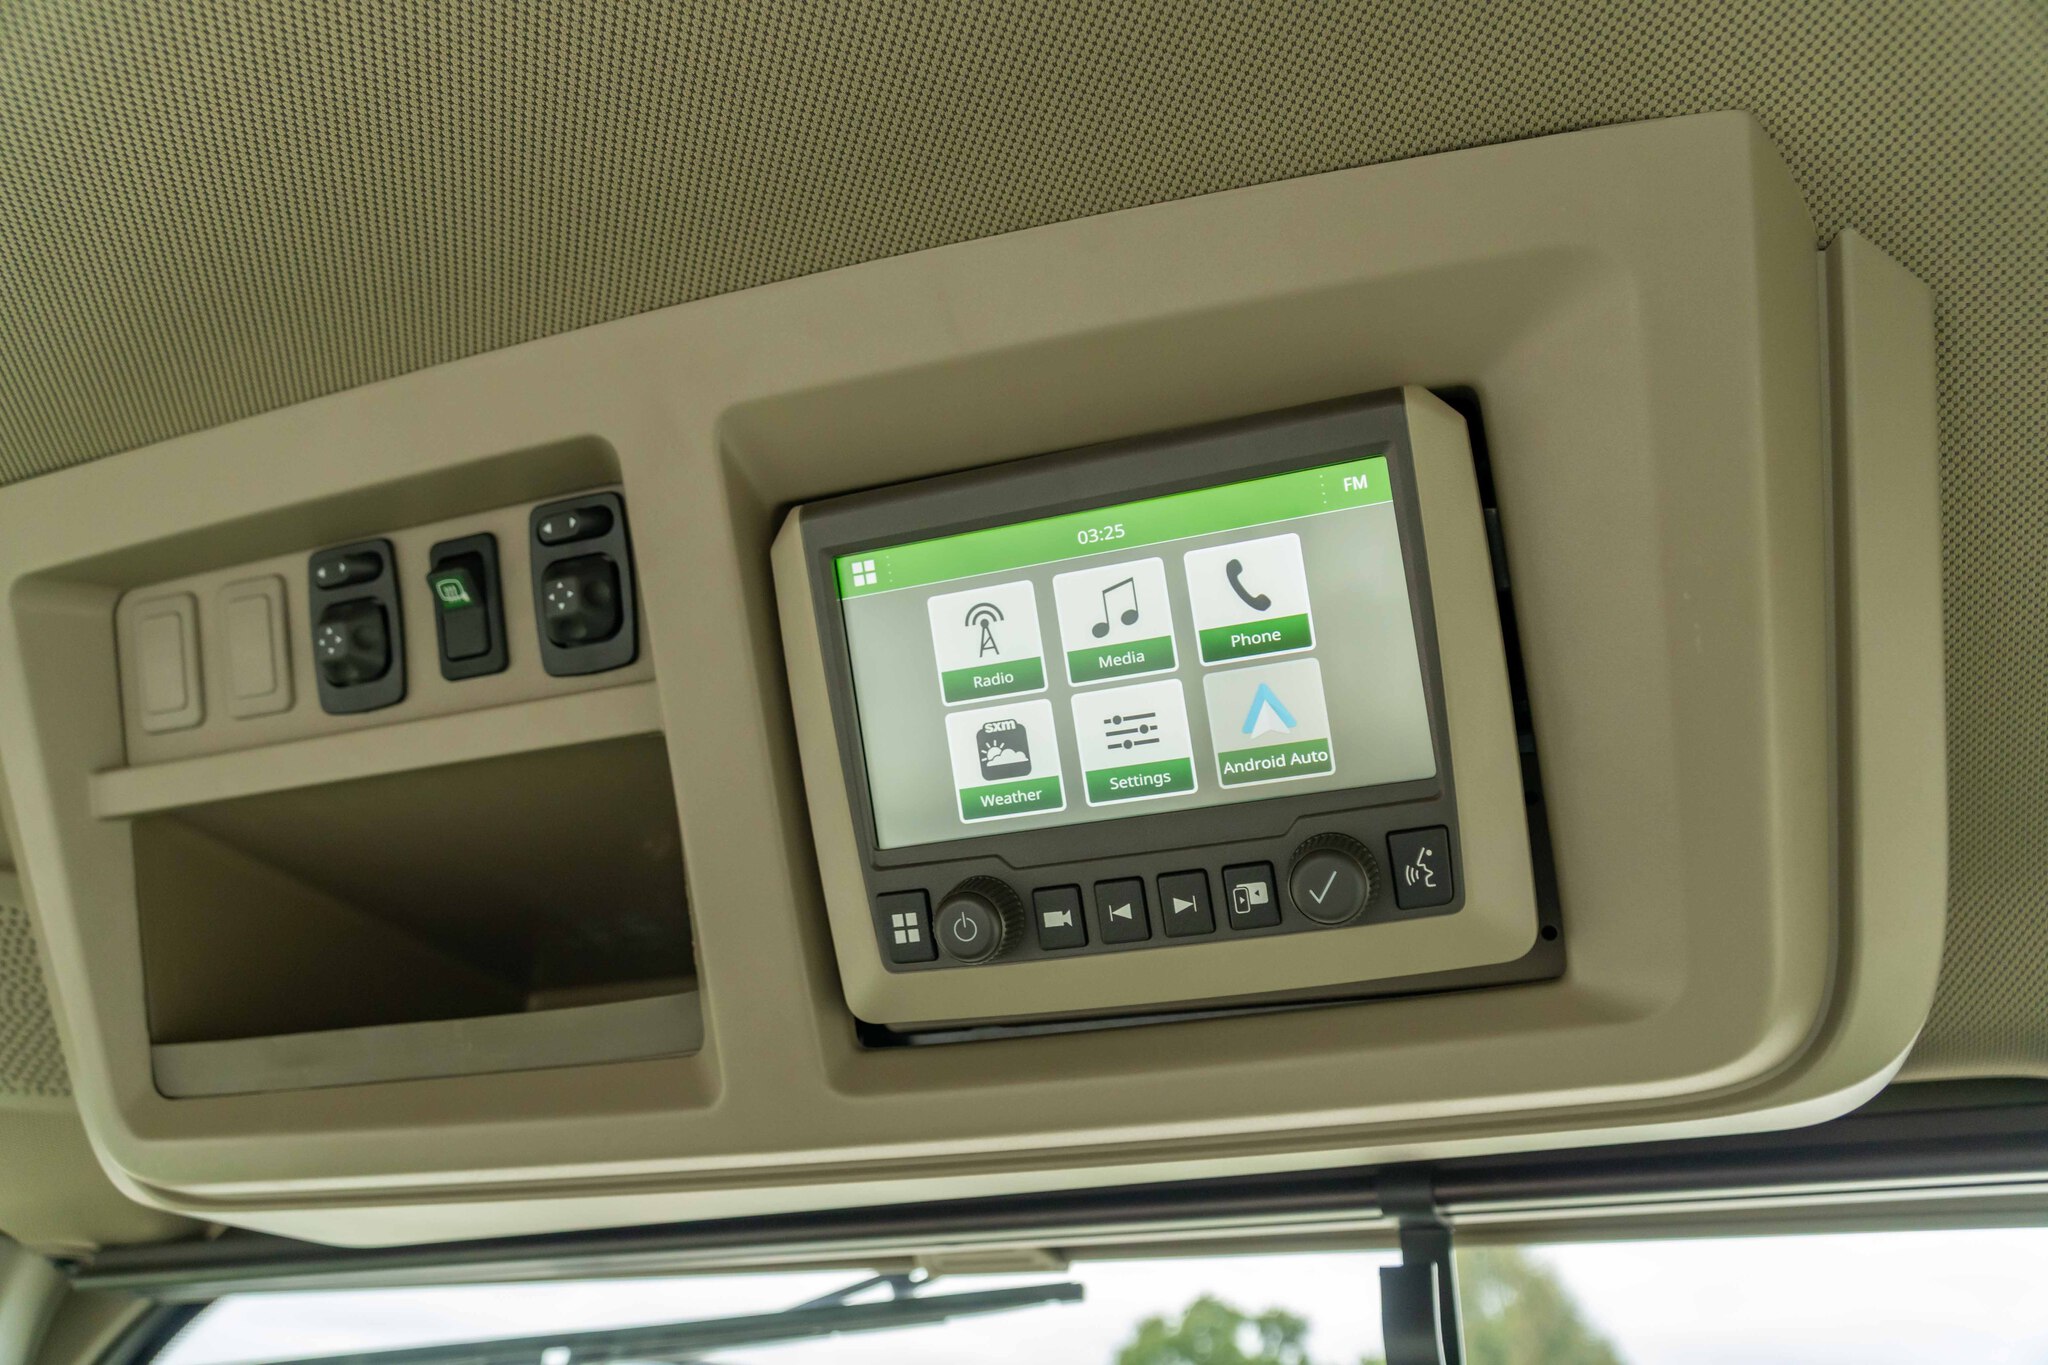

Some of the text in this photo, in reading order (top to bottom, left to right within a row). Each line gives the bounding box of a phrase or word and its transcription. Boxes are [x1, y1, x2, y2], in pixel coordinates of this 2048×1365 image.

[1343, 474, 1368, 492] FM
[1077, 523, 1125, 544] 03:25
[1230, 628, 1282, 647] Phone
[1098, 651, 1145, 669] Media
[973, 671, 1014, 688] Radio
[984, 719, 1016, 733] sxm
[1223, 749, 1328, 775] Android Auto
[1109, 771, 1171, 791] Settings
[980, 789, 1042, 808] Weather
